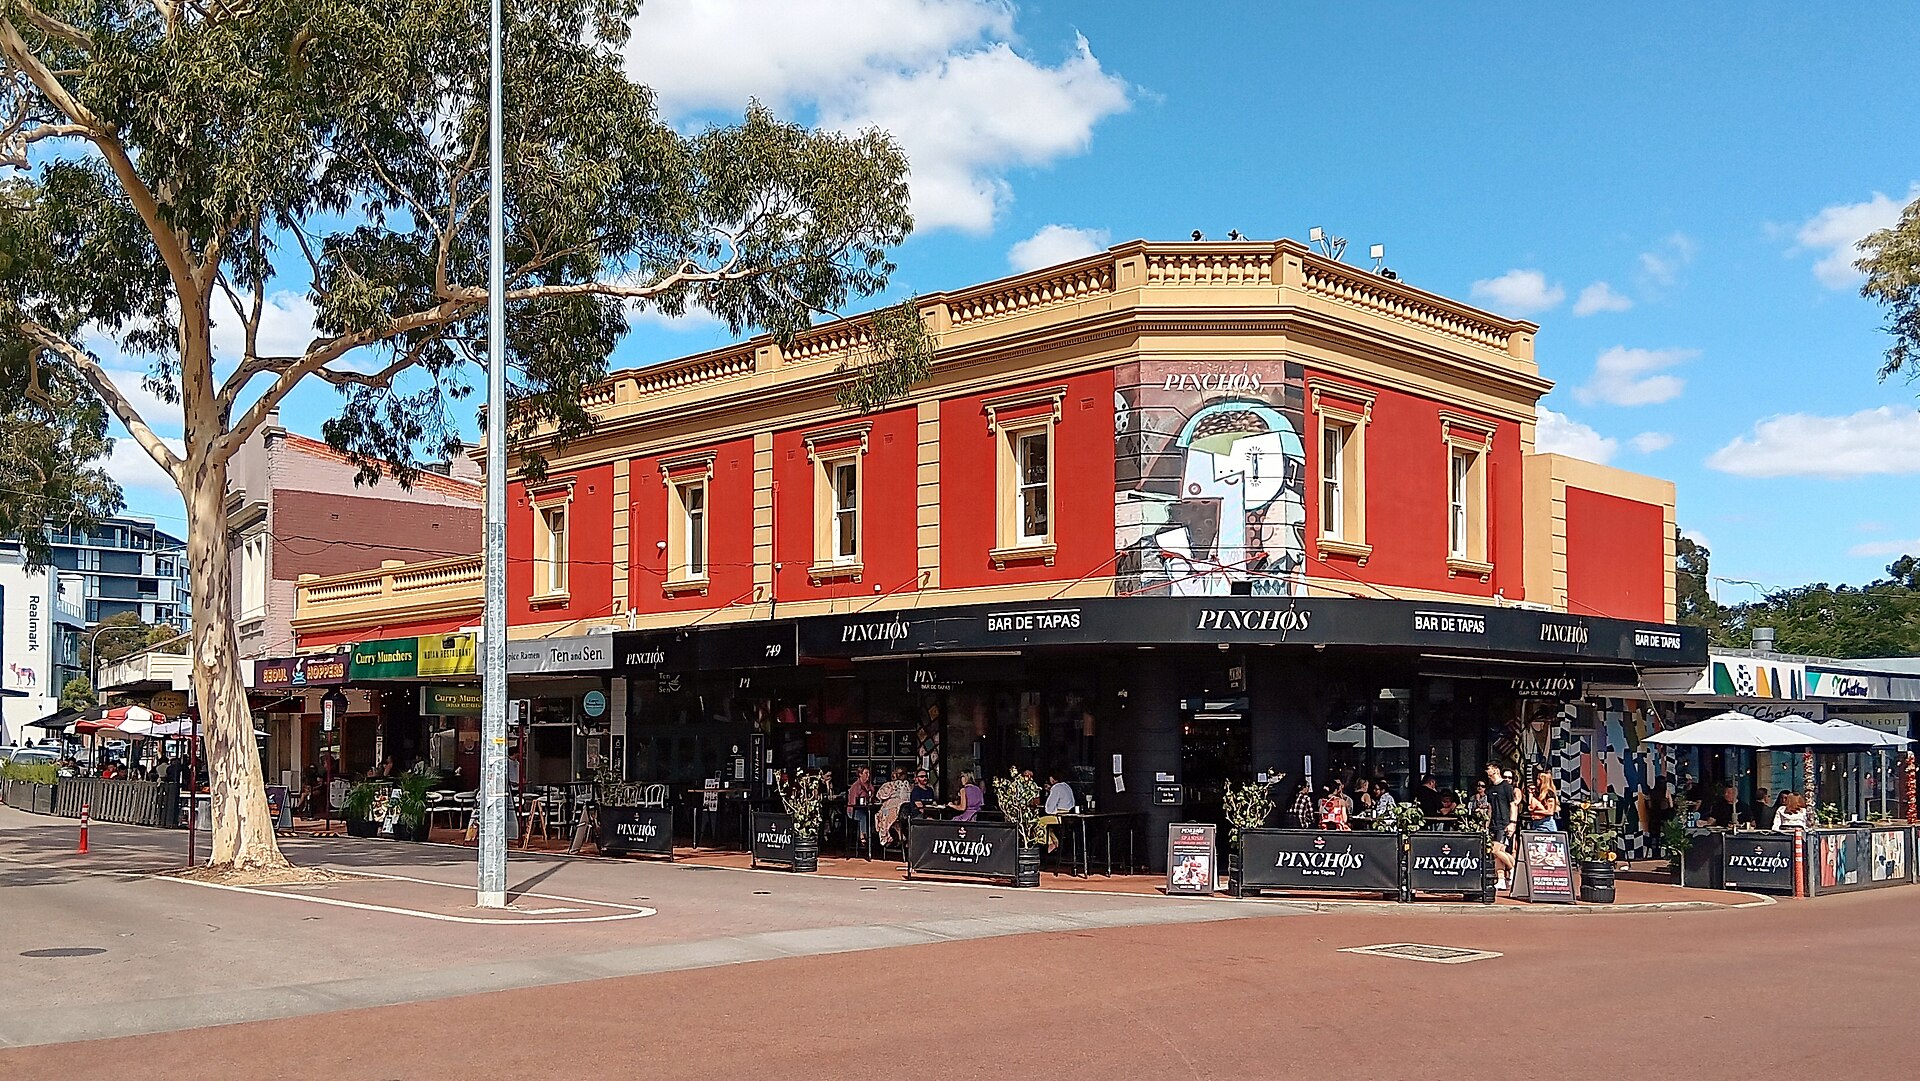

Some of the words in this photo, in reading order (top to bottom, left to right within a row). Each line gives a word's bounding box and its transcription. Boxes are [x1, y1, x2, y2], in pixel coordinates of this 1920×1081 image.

[28, 595, 39, 651] Realmark
[988, 618, 1012, 631] BAR
[1015, 616, 1033, 630] DE
[1036, 614, 1080, 629] TAPAS
[1415, 616, 1438, 631] BAR
[1441, 617, 1455, 631] DE
[1457, 618, 1485, 634] TAPAS
[1635, 634, 1649, 646] BAR
[1650, 636, 1660, 648] DE
[1661, 636, 1680, 649] TAPAS
[355, 652, 375, 666] Curry
[377, 649, 413, 663] Munchers
[423, 651, 439, 660] NDIAN
[440, 648, 471, 660] RESTAURANT
[507, 652, 520, 663] pice
[520, 651, 540, 660] Ramen
[550, 648, 569, 663] Ten
[570, 651, 582, 660] and
[765, 643, 781, 657] 749
[263, 667, 288, 683] SEOUL
[306, 663, 344, 680] HOPPERS
[1839, 678, 1869, 697] Chatime
[434, 694, 457, 703] Curry
[1878, 718, 1902, 726] EDIT
